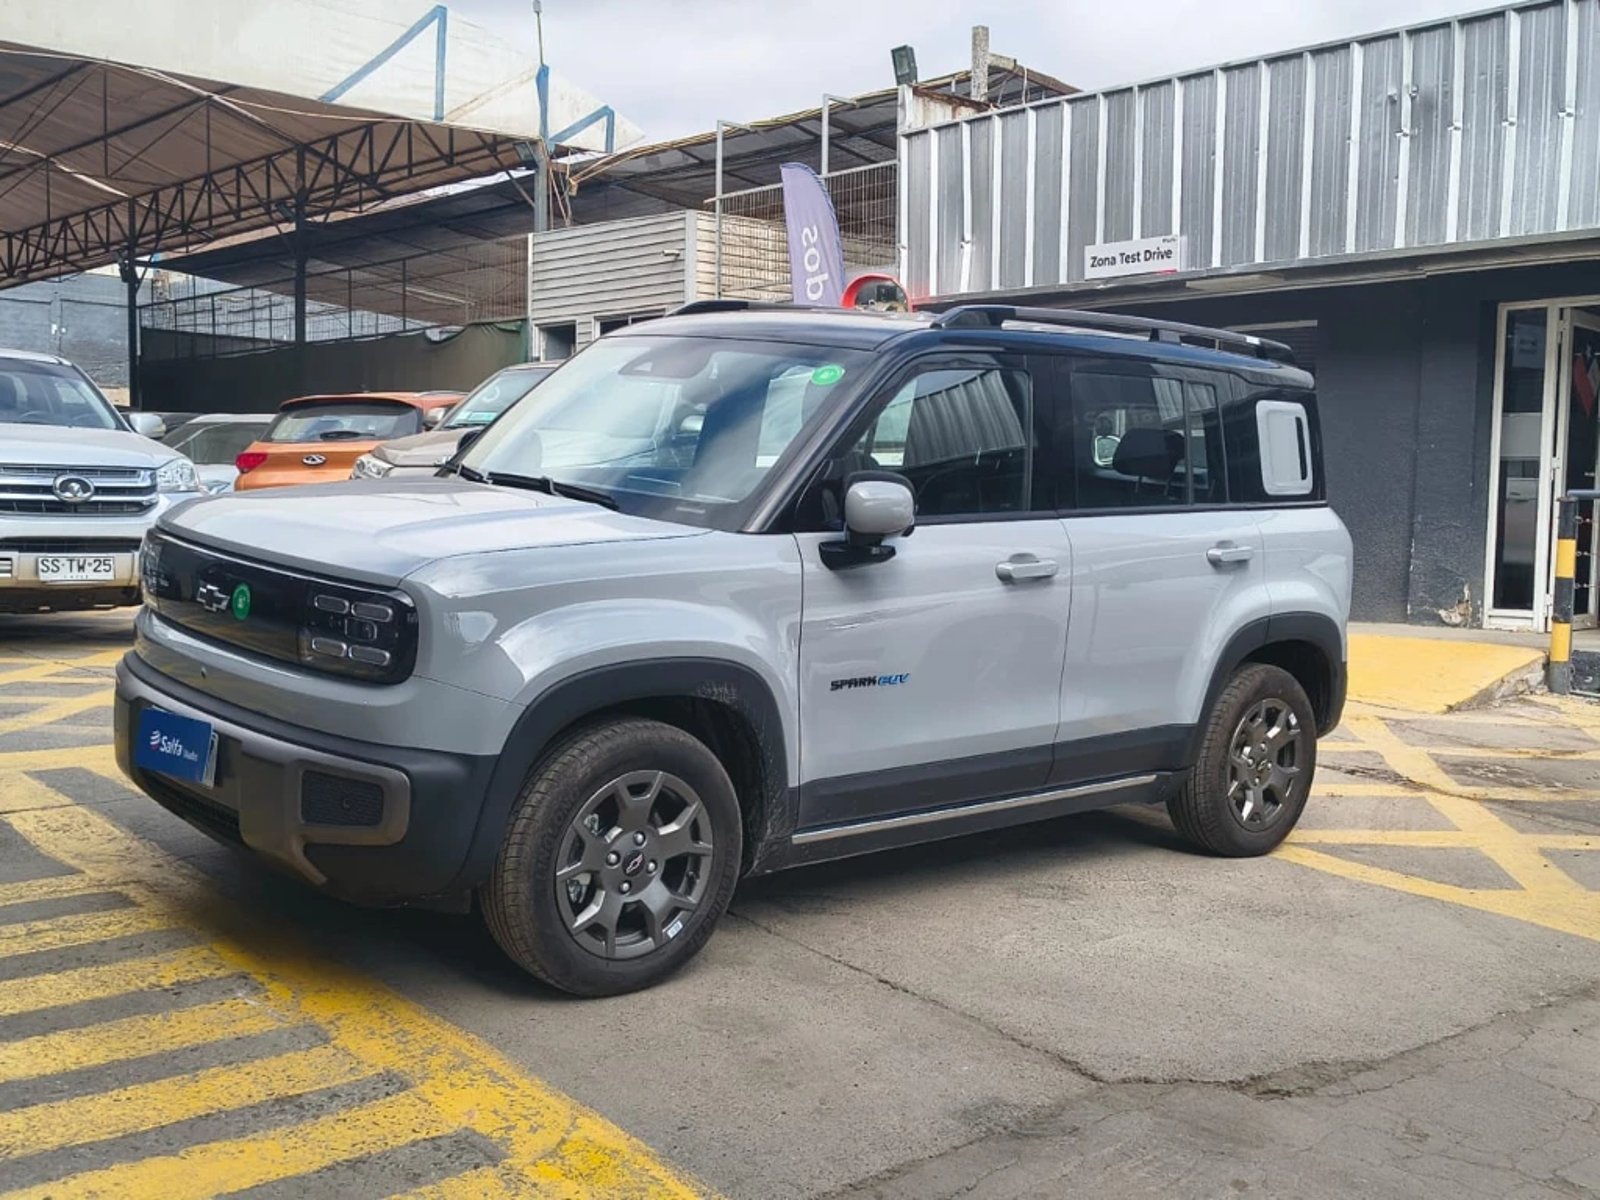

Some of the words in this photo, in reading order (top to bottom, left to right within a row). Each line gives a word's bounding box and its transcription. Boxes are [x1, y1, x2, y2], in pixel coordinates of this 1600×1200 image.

[1090, 255, 1116, 268] Zona
[1119, 252, 1142, 265] Test
[1143, 246, 1173, 262] Drive
[159, 735, 183, 757] Salfa
